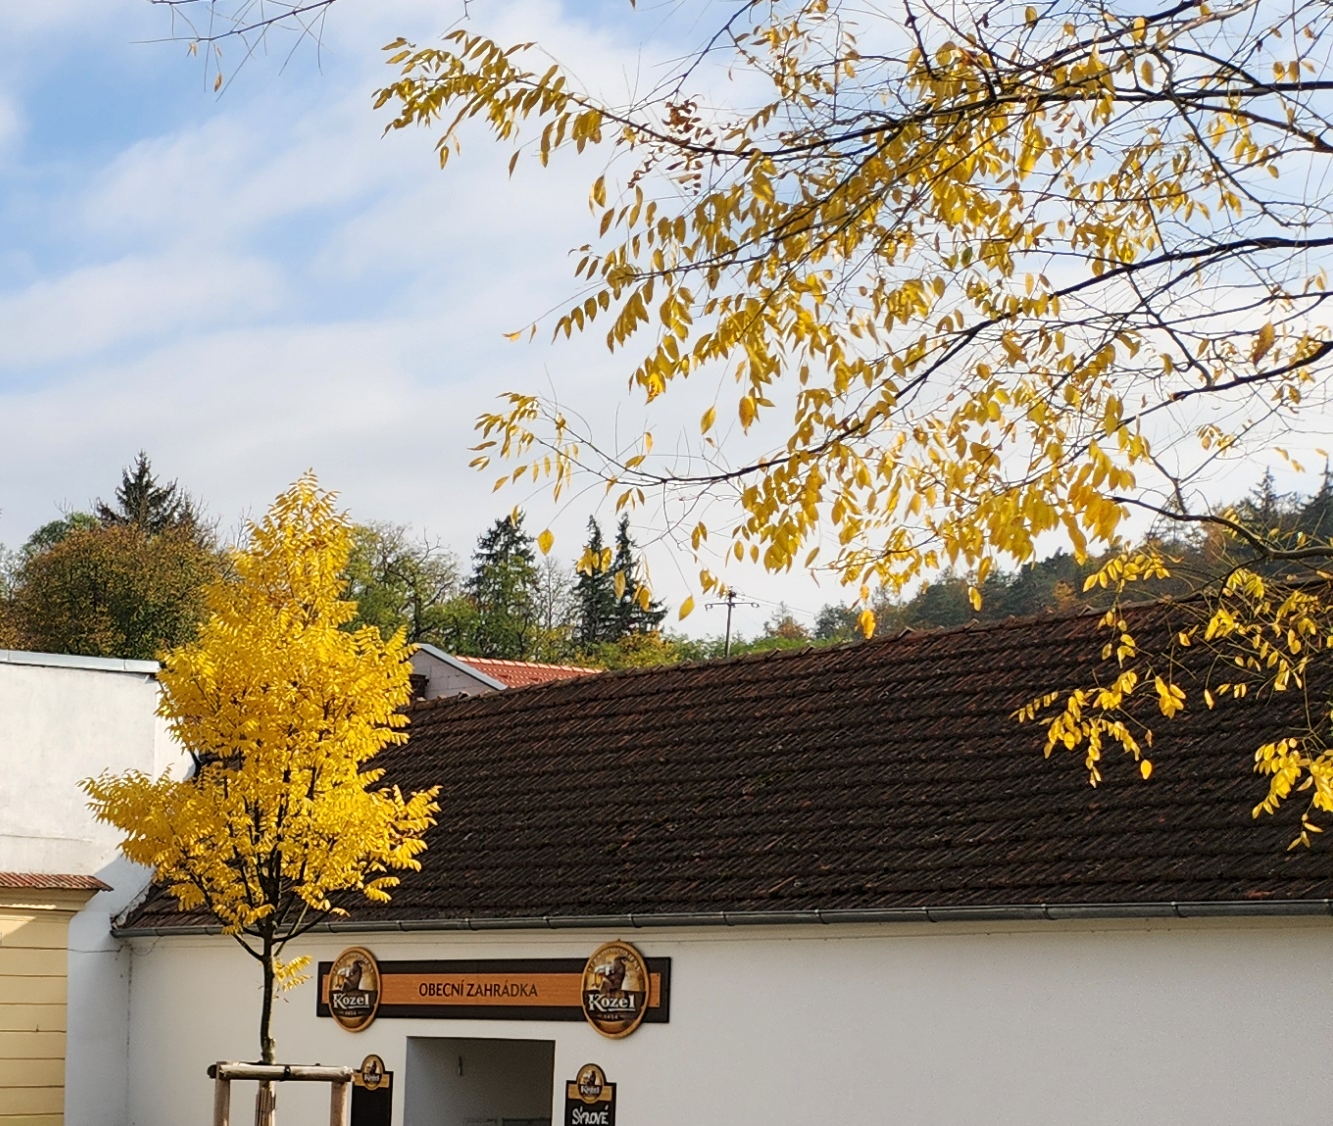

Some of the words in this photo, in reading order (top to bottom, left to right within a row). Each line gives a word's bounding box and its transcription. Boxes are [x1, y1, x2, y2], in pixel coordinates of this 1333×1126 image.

[419, 979, 465, 997] OBECNÍ
[466, 979, 538, 997] ZAHRÁDKA
[333, 993, 370, 1010] Kozel
[588, 994, 636, 1012] Kozel
